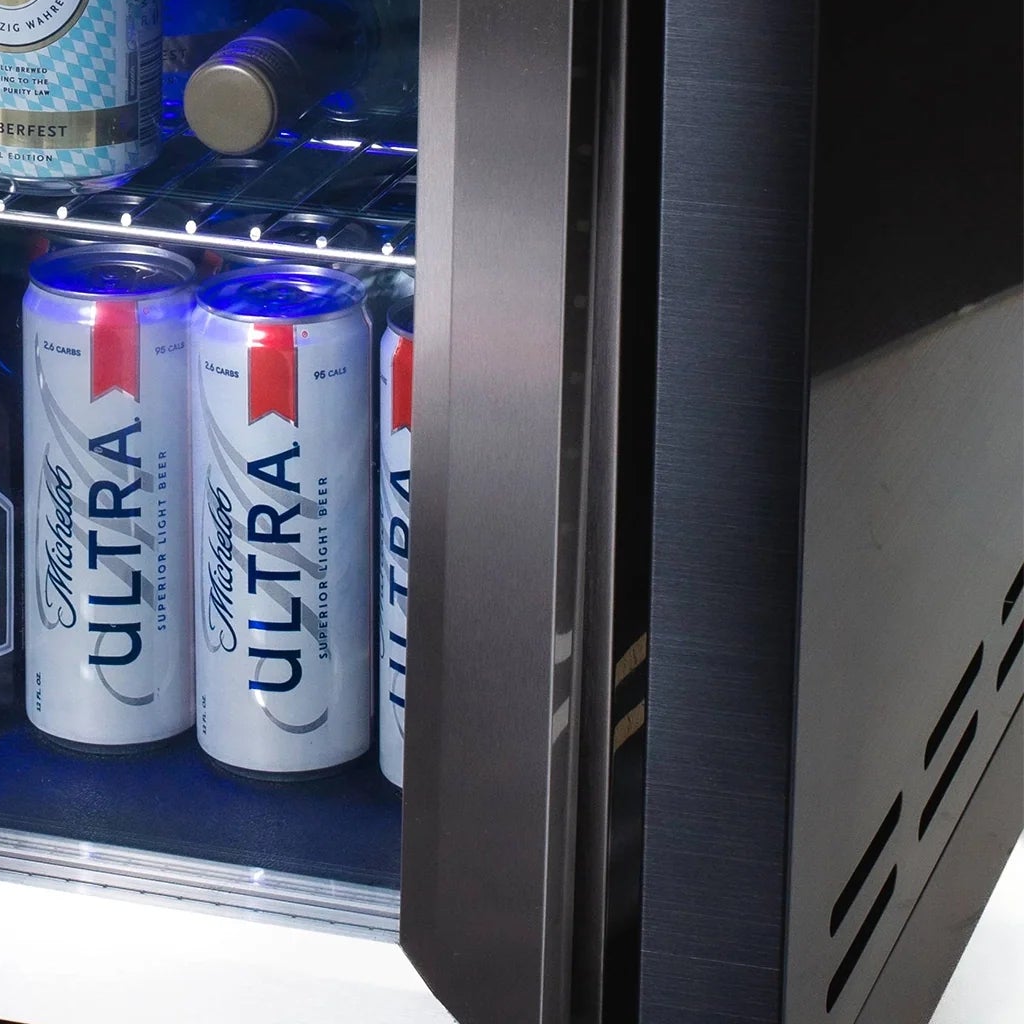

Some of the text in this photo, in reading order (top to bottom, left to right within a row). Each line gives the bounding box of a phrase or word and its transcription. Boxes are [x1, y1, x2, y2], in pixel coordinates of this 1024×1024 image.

[15, 66, 48, 74] BREWED
[18, 76, 29, 84] TO
[31, 78, 49, 86] THE
[3, 86, 31, 95] PURITY
[8, 152, 53, 163] EDITION
[55, 346, 82, 357] CARBS
[154, 341, 185, 355] 95 CALS
[215, 365, 240, 378] CARBS
[313, 365, 348, 380] 95 CALS
[45, 454, 77, 629] Michelob
[88, 419, 142, 665] ULTRA
[157, 450, 168, 631] SUPERIOR LIGHT BEER
[207, 477, 237, 653] Michelob
[248, 442, 303, 692] ULTRA
[319, 477, 328, 659] SUPERIOR LIGHT BEER
